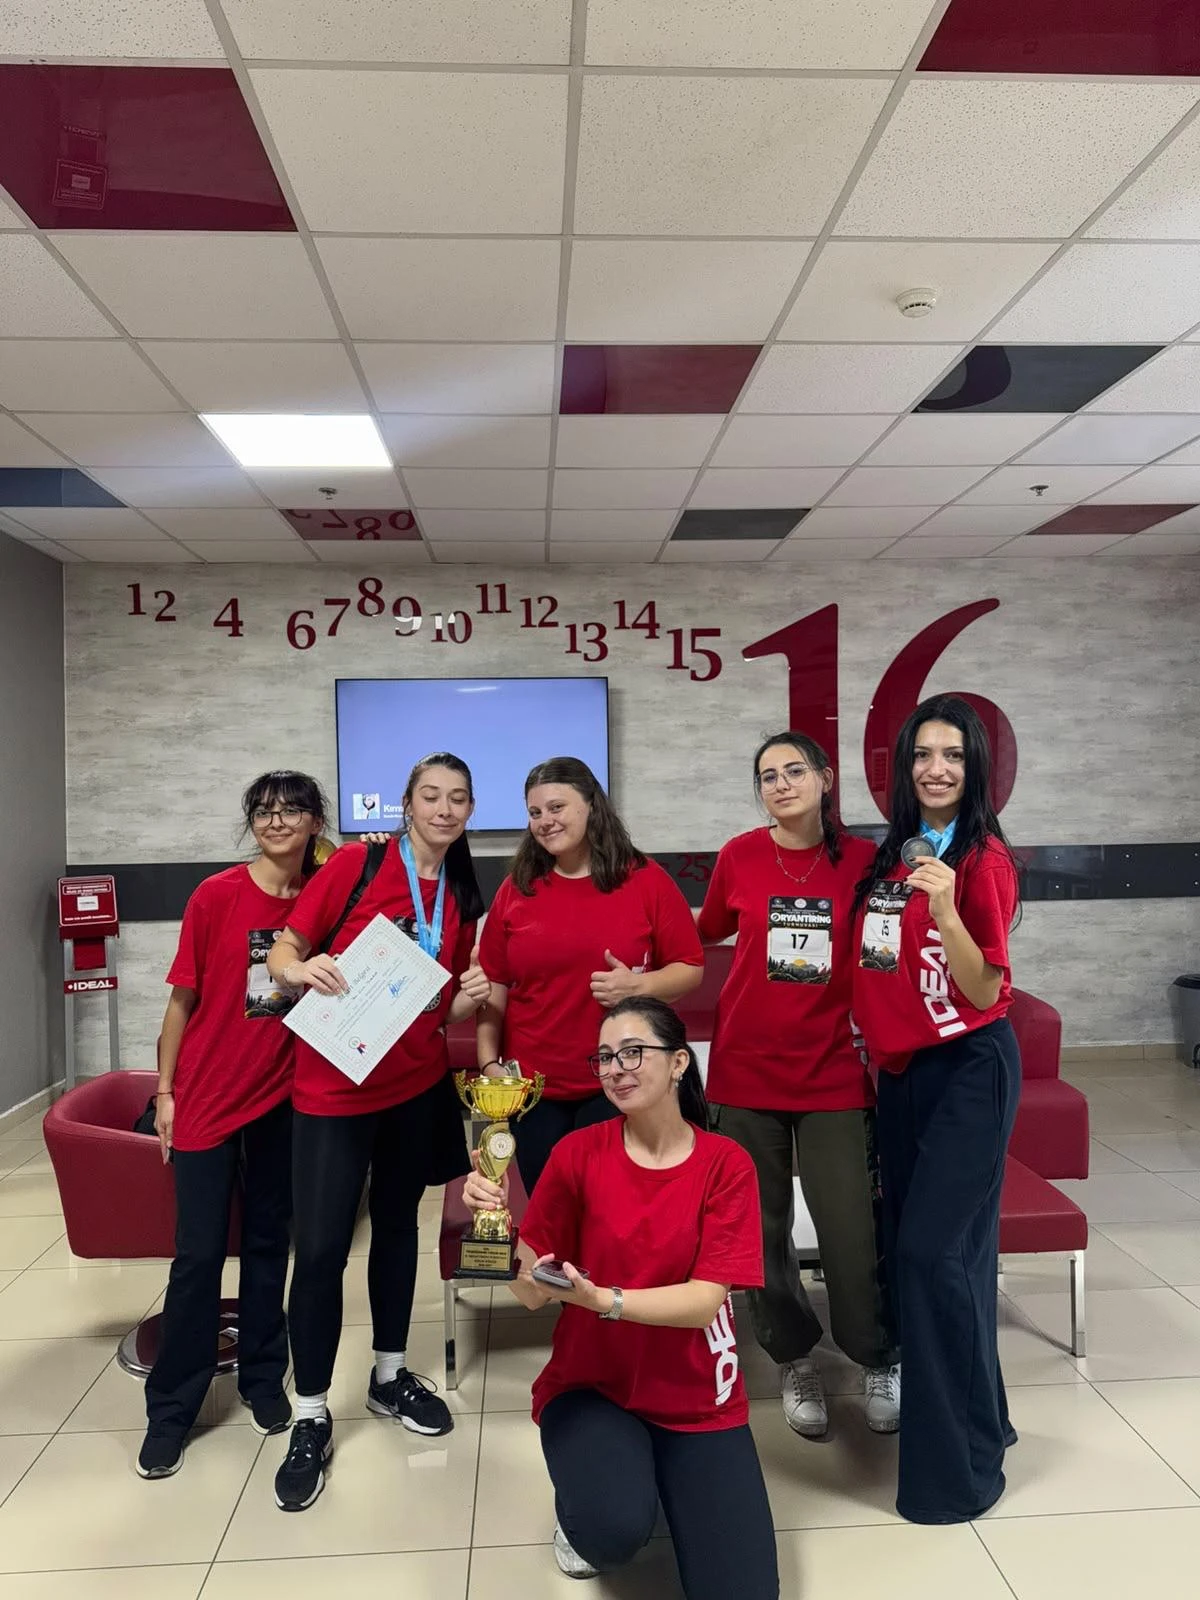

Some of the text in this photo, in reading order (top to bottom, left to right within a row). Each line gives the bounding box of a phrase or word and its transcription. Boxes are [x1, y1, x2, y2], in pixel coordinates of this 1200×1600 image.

[127, 577, 723, 681] 1 2 4 6 7 8 9 10 11 12 13 14 15
[741, 597, 1018, 828] 16
[791, 933, 809, 950] 17
[73, 979, 115, 991] IDEAL
